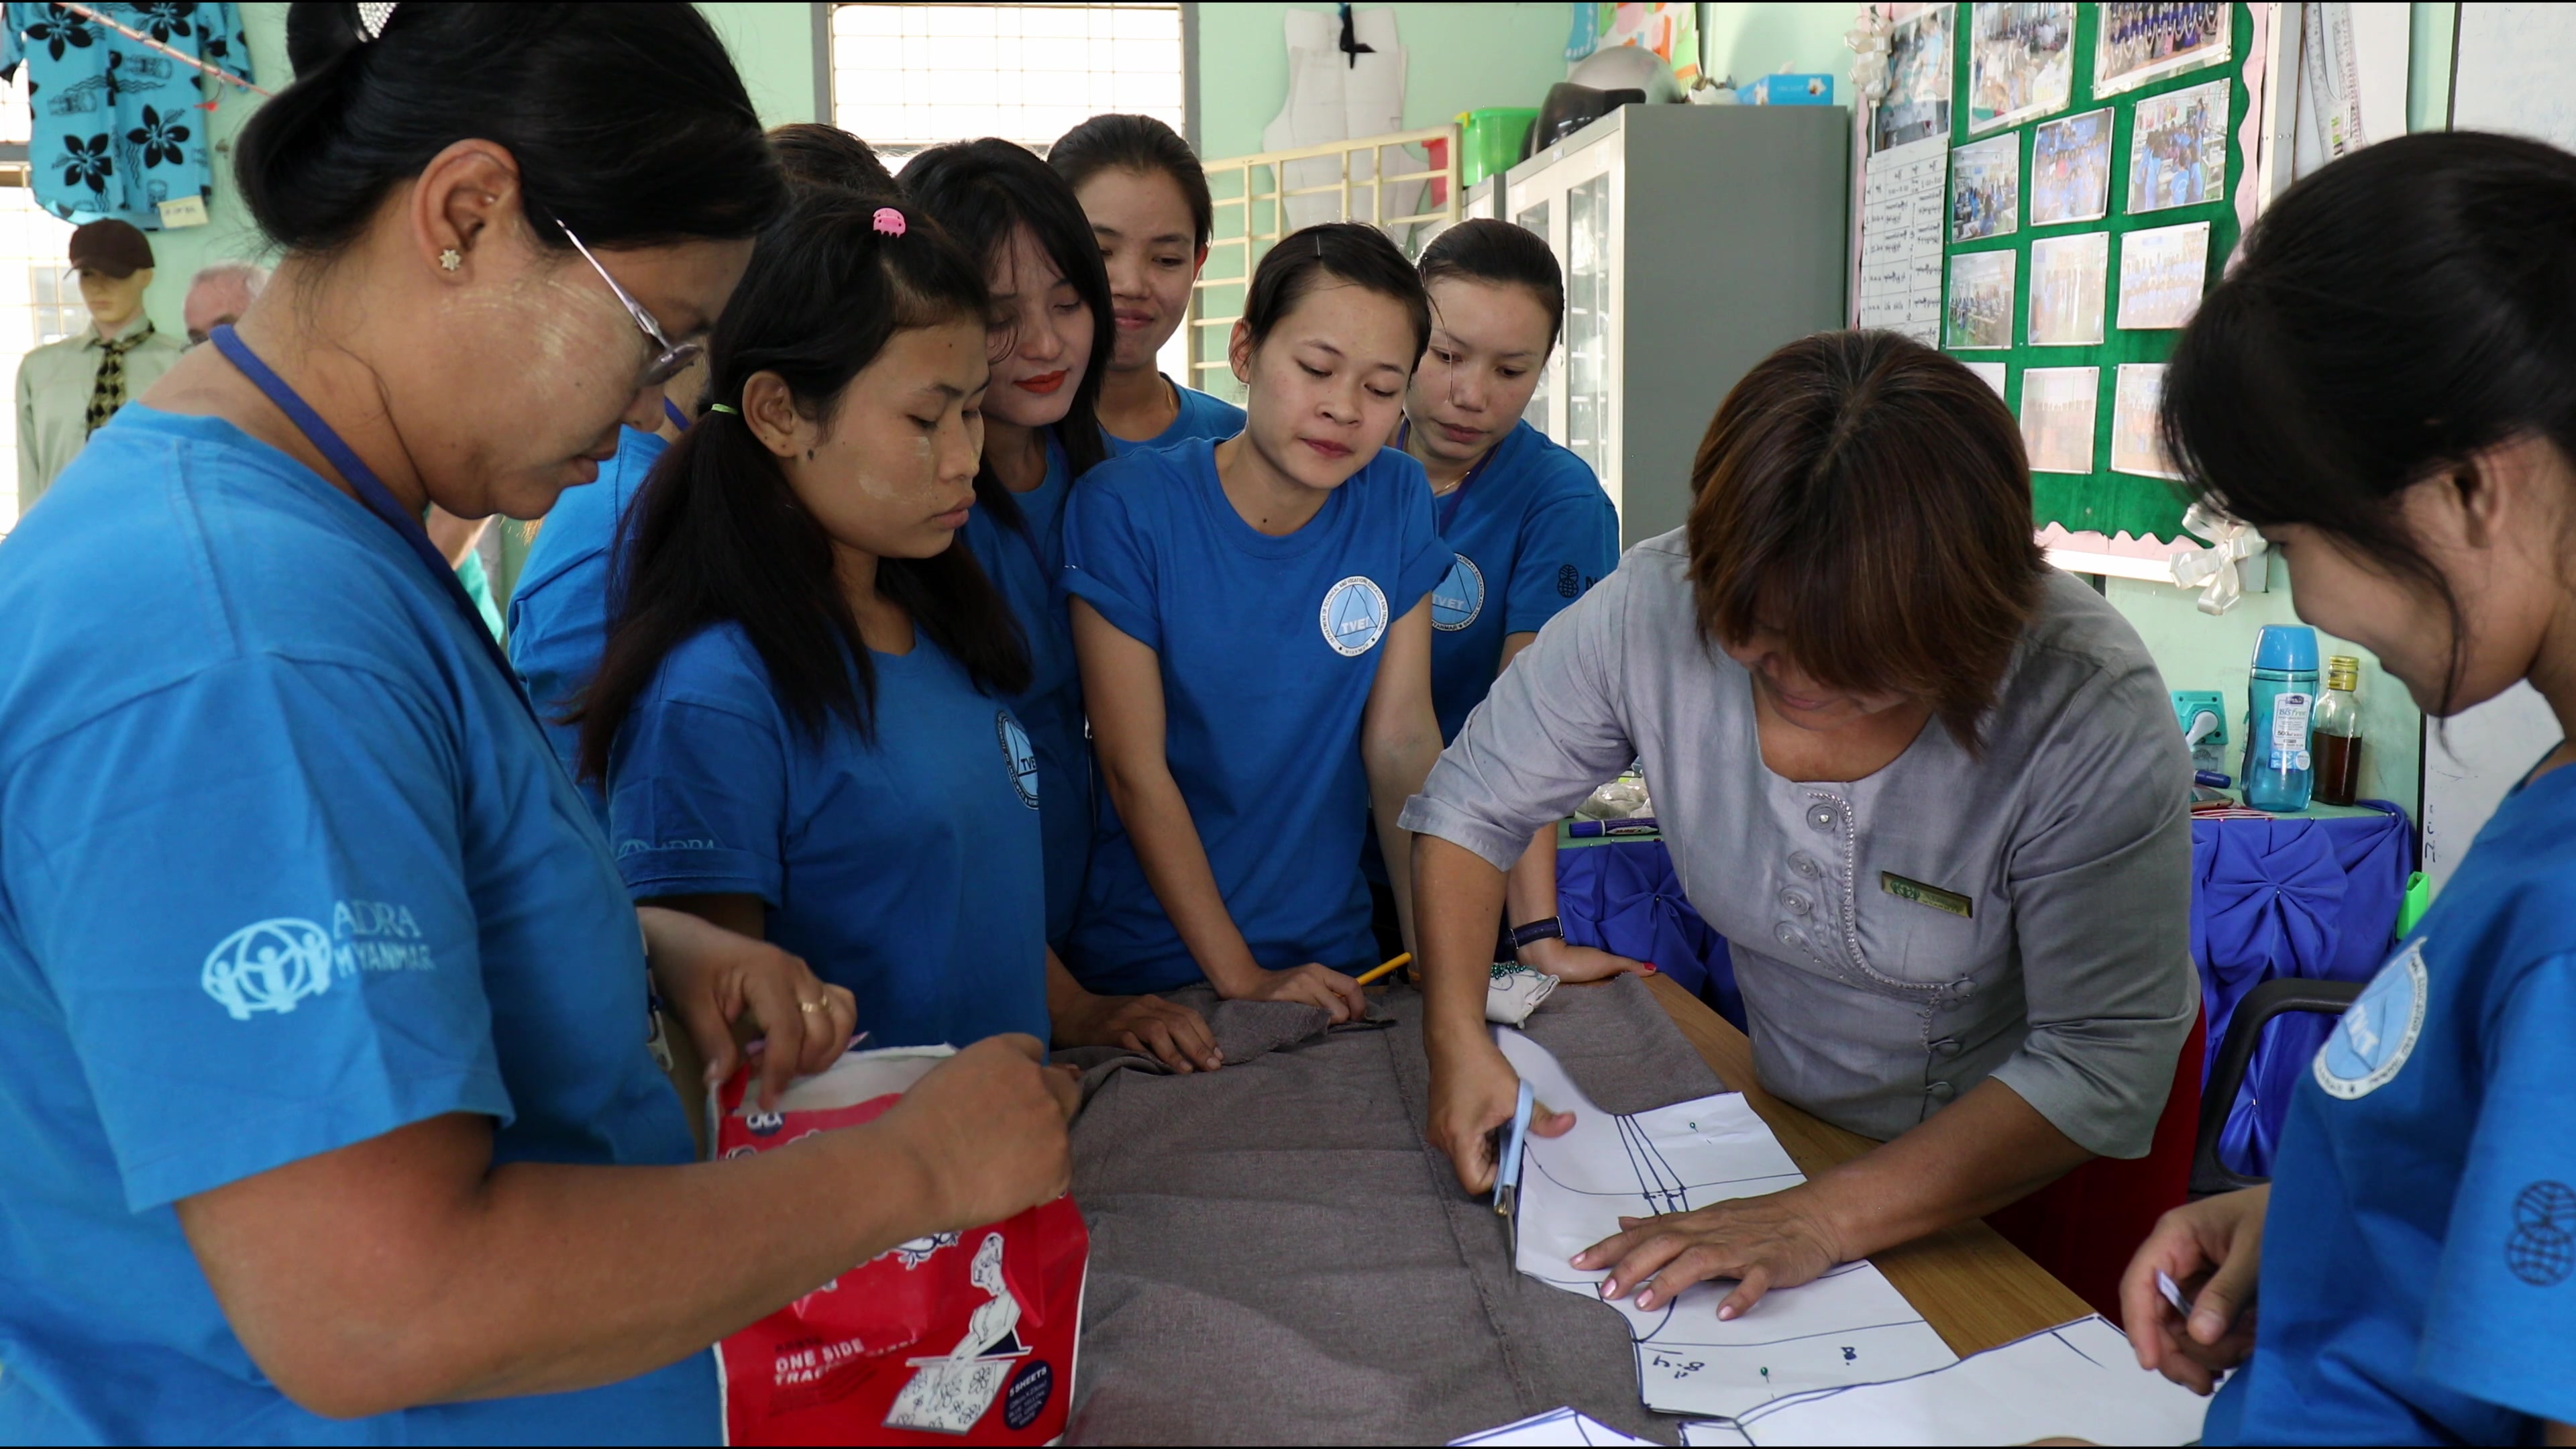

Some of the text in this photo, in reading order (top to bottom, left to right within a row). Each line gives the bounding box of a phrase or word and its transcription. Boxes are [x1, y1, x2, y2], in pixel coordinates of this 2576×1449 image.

[1432, 622, 1457, 630] YANMAR
[1020, 756, 1036, 771] TVE
[333, 900, 422, 941] ADRA
[335, 943, 437, 978] MYANMAR
[775, 1350, 816, 1373] ONE
[822, 1338, 865, 1362] SIDE
[1015, 1366, 1046, 1393] SHEETS
